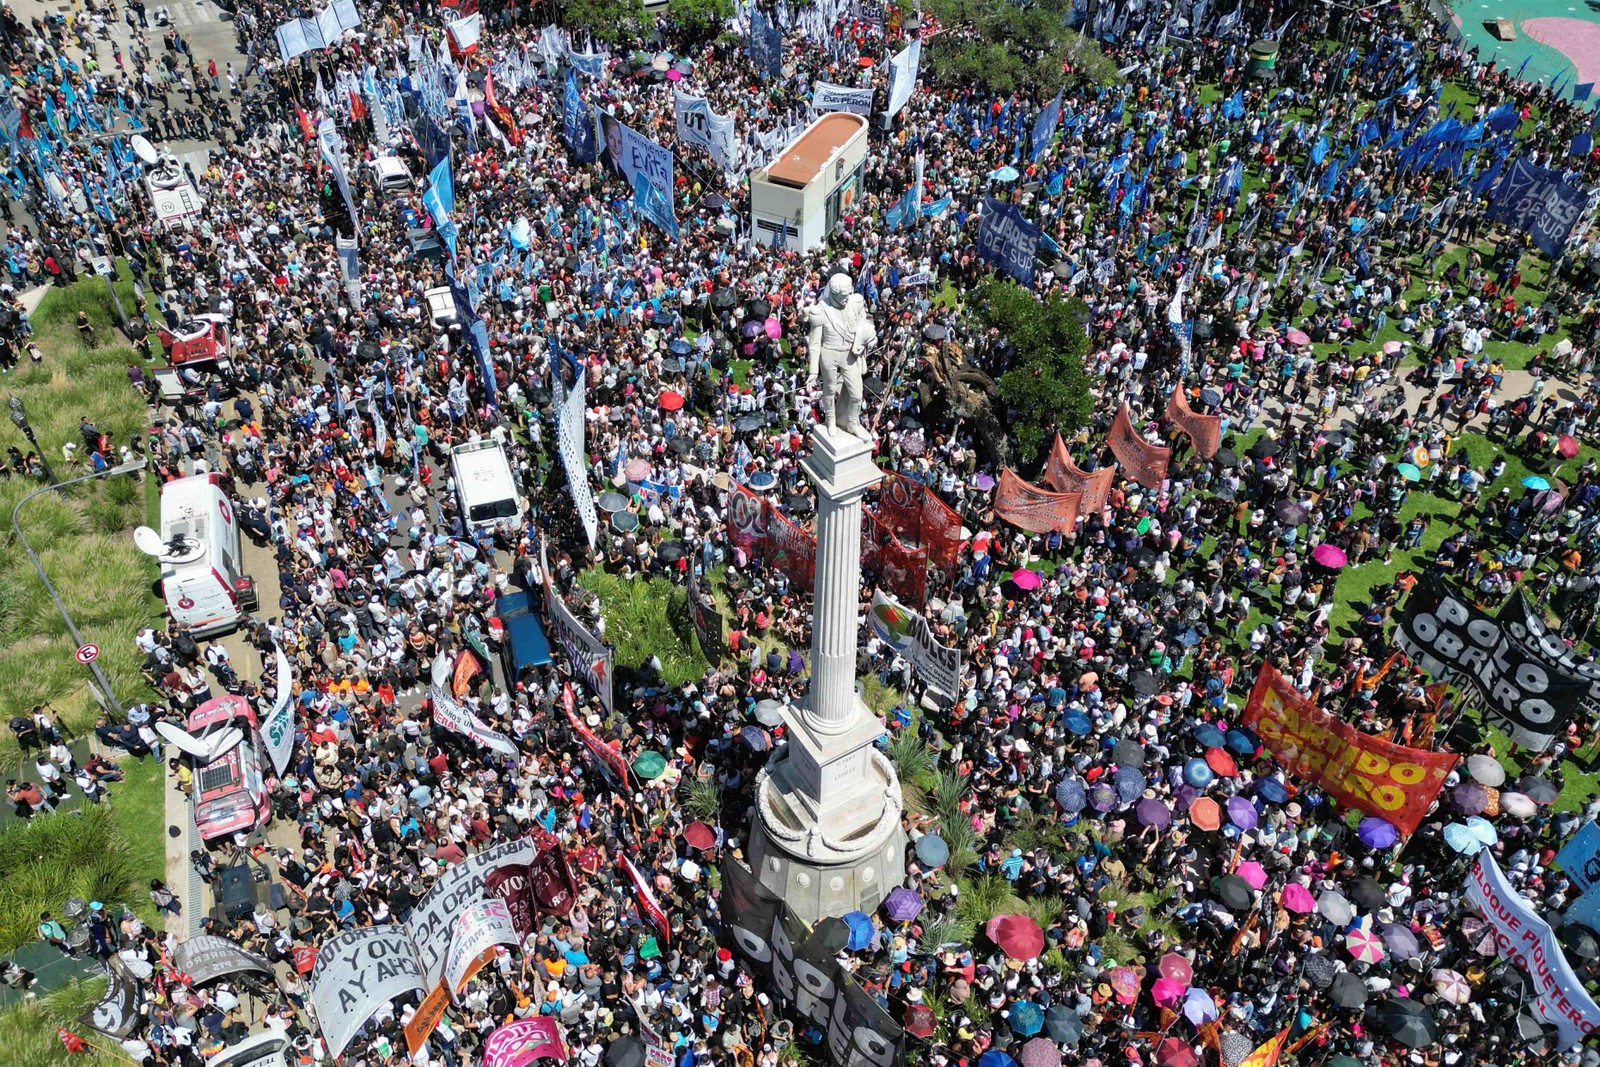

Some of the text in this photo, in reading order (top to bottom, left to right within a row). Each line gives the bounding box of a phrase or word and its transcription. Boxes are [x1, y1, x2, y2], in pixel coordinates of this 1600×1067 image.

[983, 230, 1007, 258] DEL
[990, 212, 1037, 256] LIBRES
[1009, 248, 1034, 274] SUR
[1537, 212, 1564, 242] SUR
[905, 614, 957, 672] MULCS
[1412, 612, 1556, 724] OBRERO
[1436, 596, 1549, 693] POLO
[1405, 641, 1515, 739] LA MATANZA
[1259, 717, 1406, 812] OBRERO
[1262, 686, 1427, 785] PARTIDO
[1471, 860, 1522, 933] BLOQUE
[771, 915, 896, 1067] POLO
[1521, 928, 1600, 1035] PIQUETERO
[650, 1049, 673, 1062] PARO
